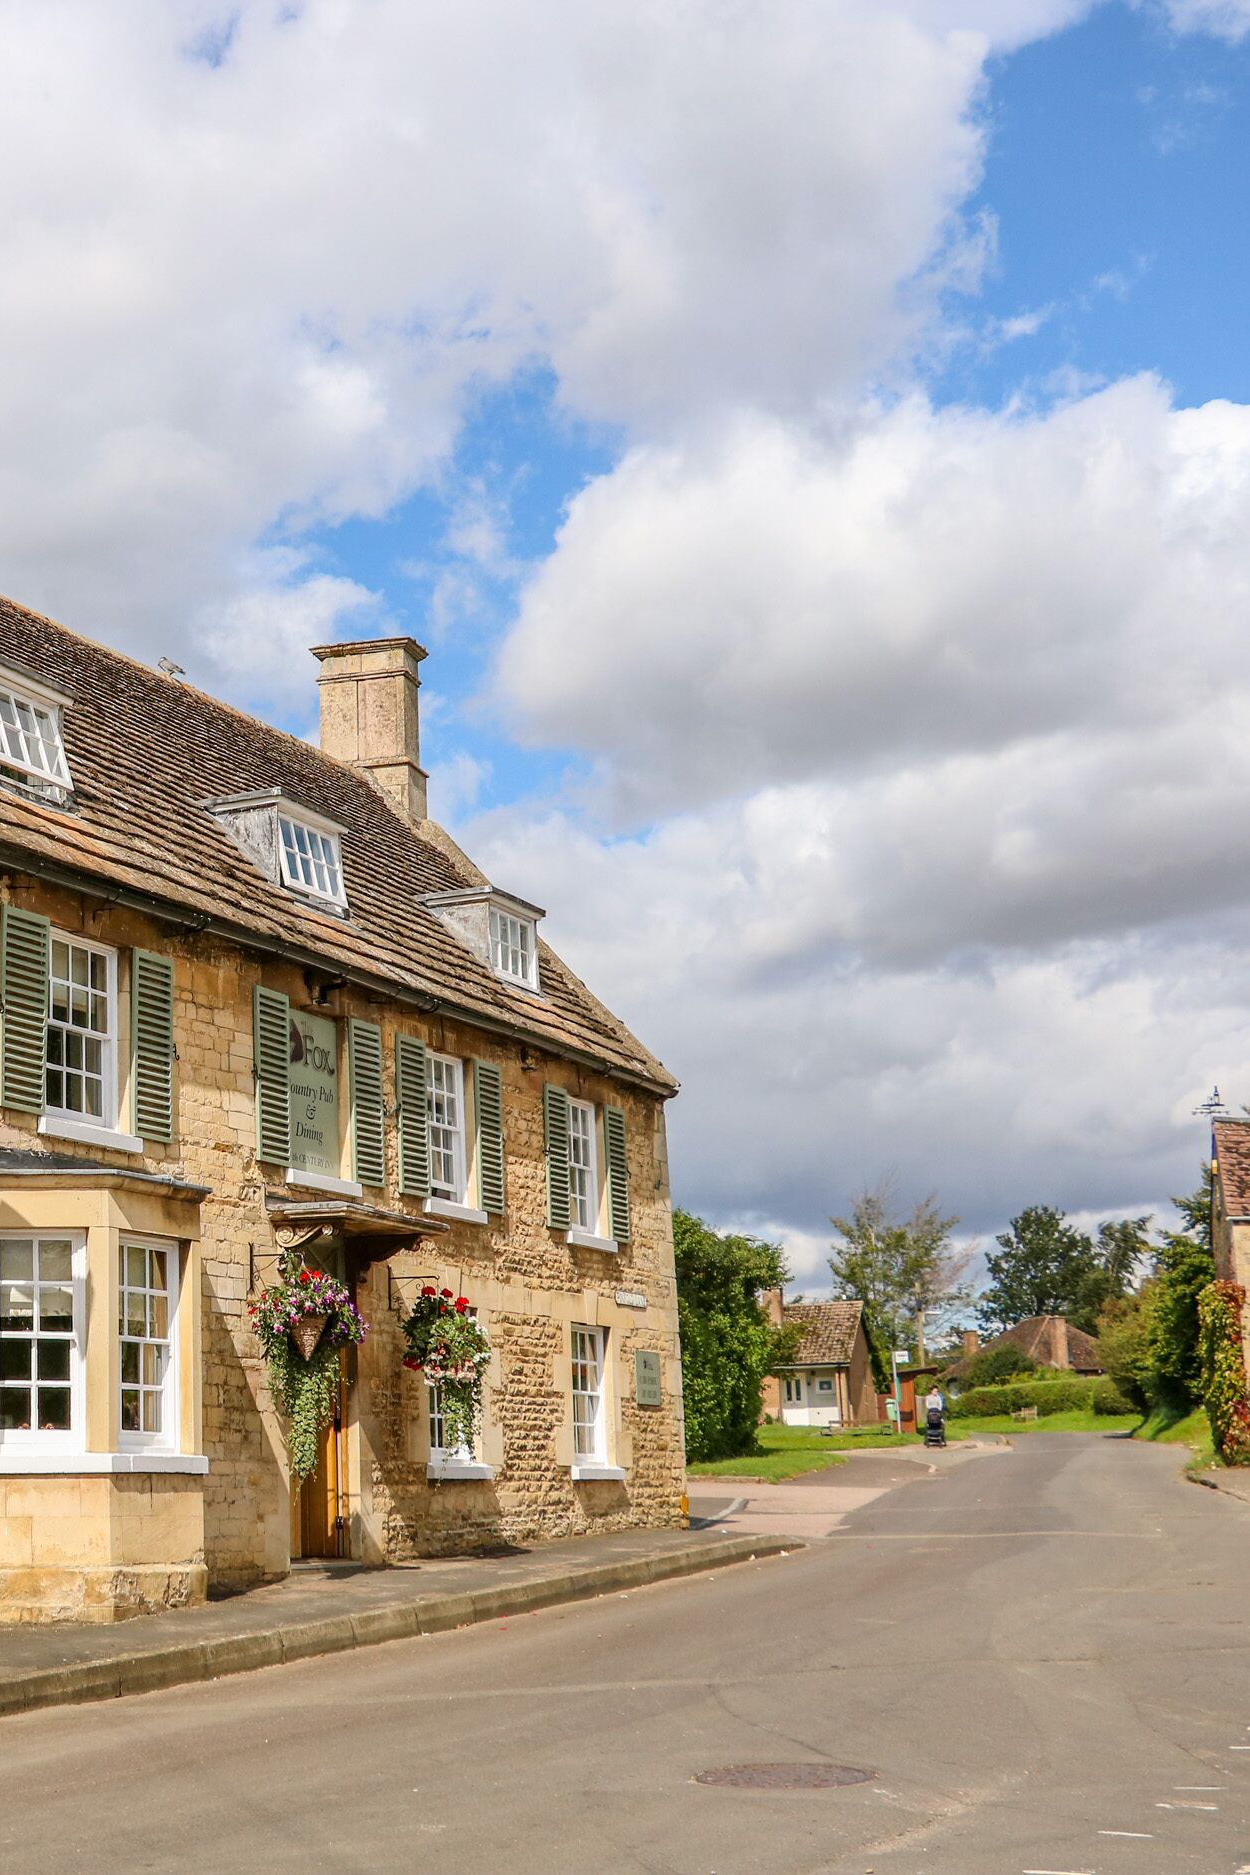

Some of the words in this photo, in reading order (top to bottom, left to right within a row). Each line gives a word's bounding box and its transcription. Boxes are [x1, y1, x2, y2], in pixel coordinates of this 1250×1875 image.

[290, 1082, 318, 1103] ountry
[319, 1085, 334, 1105] Pub
[305, 1103, 317, 1120] &
[295, 1121, 324, 1146] Dining
